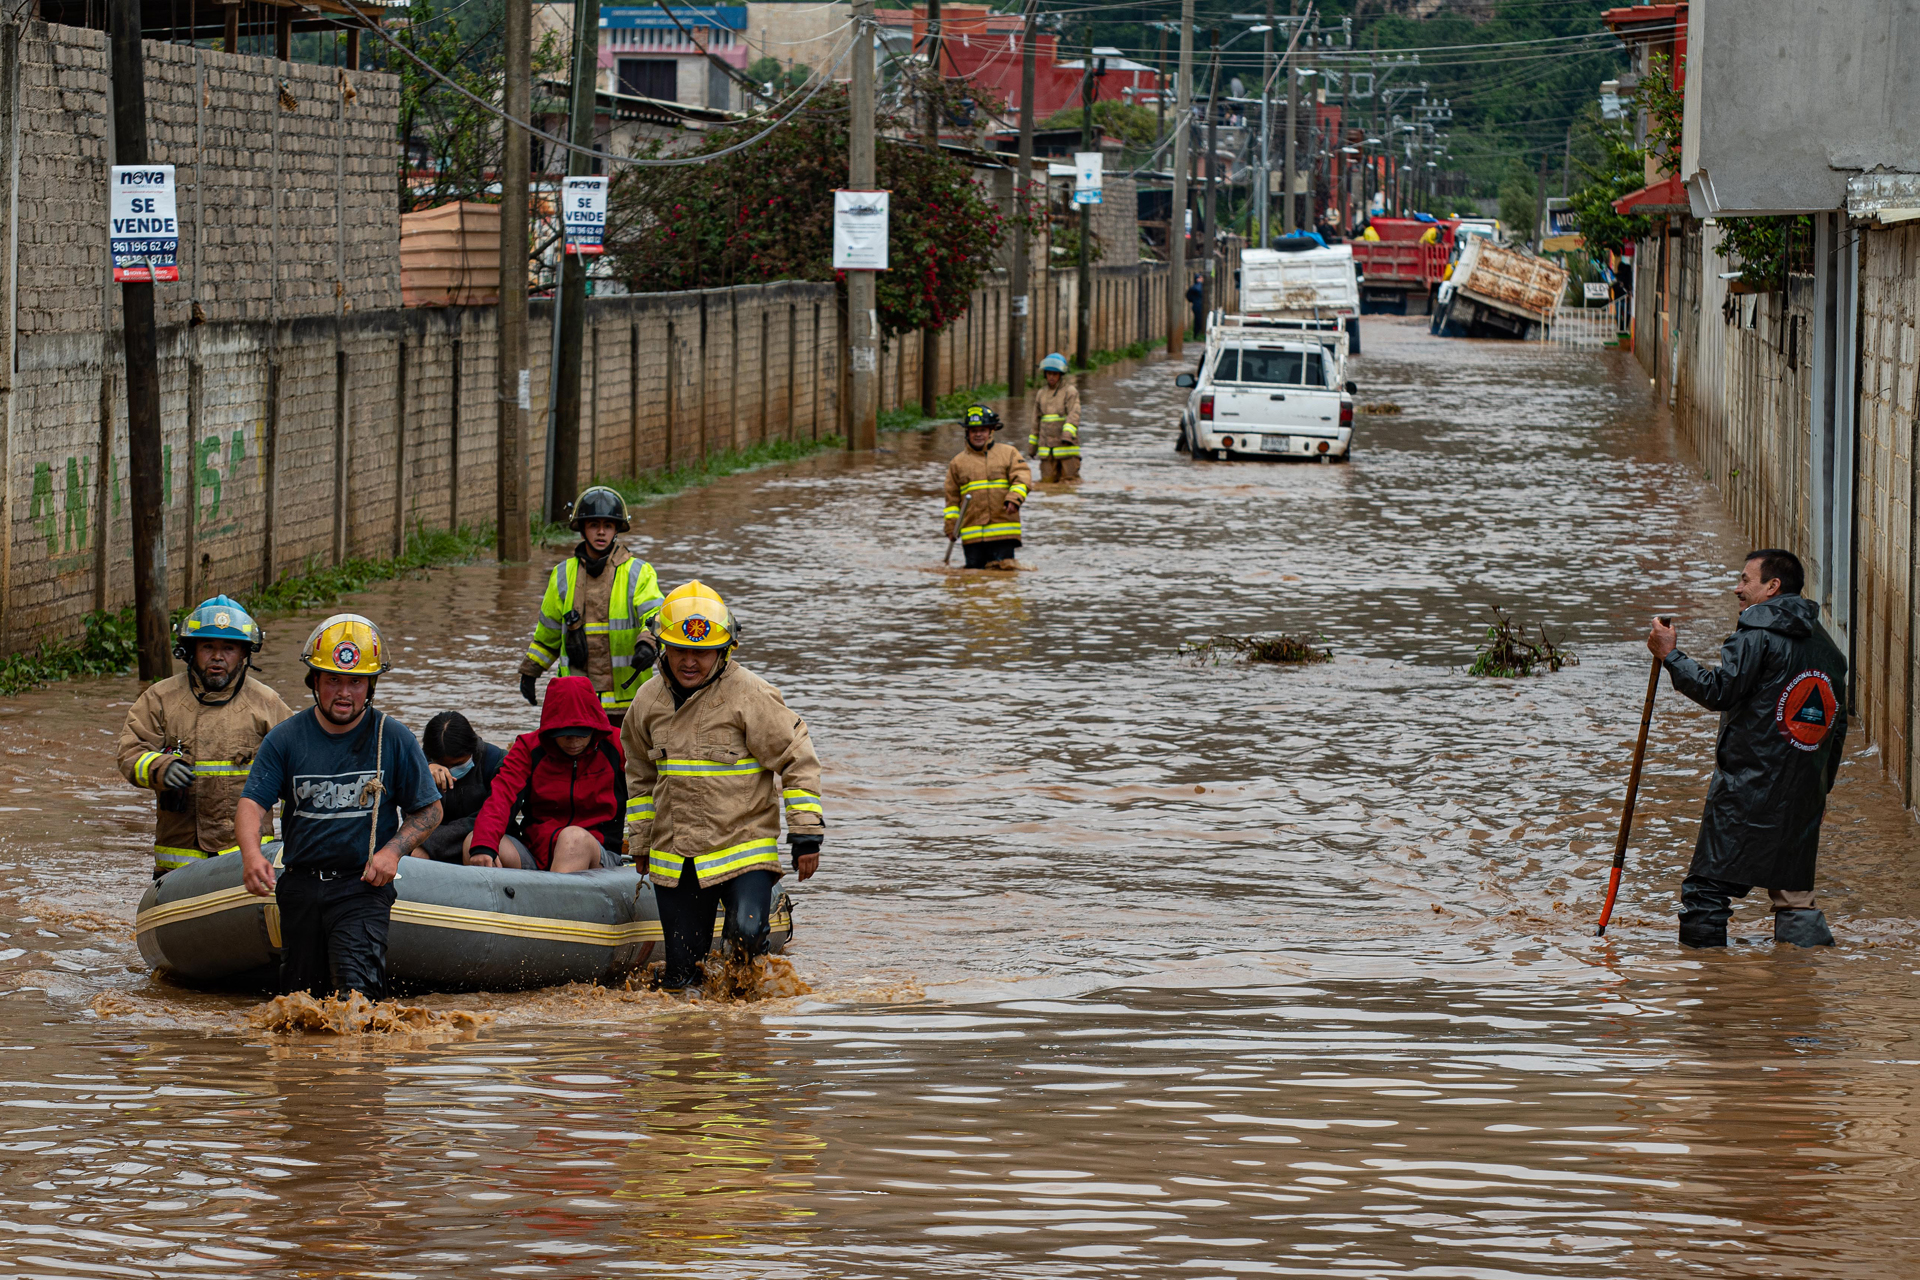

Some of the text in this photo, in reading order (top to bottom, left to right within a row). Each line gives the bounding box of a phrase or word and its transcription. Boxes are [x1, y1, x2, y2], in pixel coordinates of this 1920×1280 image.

[121, 171, 164, 185] nova
[569, 181, 600, 189] nova
[131, 198, 155, 213] SE
[577, 198, 592, 208] SE
[566, 211, 604, 222] VENDE
[114, 218, 174, 233] VENDE
[113, 241, 177, 252] 961 196 62 49
[150, 255, 163, 264] 87
[164, 254, 174, 264] 12
[1776, 692, 1789, 722] CENTRO
[1786, 670, 1813, 693] REGIONAL
[1813, 670, 1821, 678] DE
